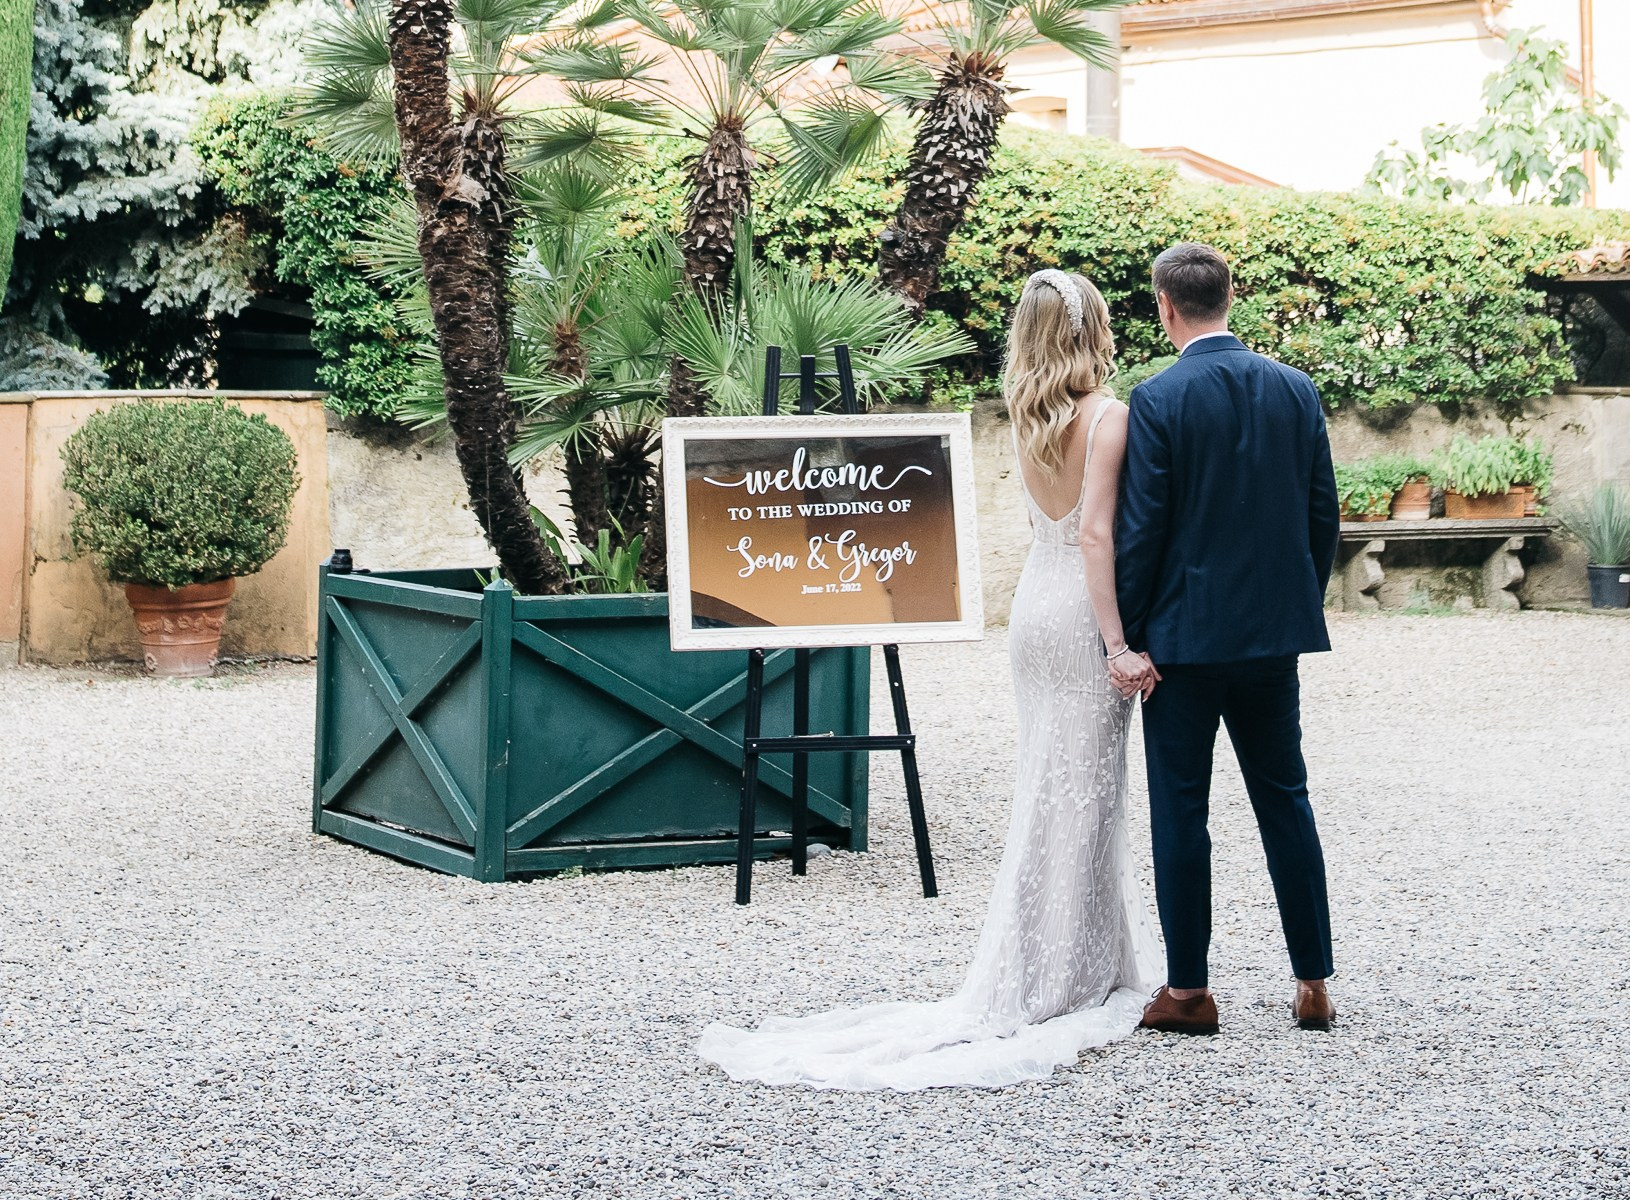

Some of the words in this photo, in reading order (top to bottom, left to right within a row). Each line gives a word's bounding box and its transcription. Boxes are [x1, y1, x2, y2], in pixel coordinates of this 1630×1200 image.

[702, 447, 932, 495] welcome
[727, 507, 753, 521] TO
[756, 505, 793, 519] THE
[797, 501, 884, 517] WEDDING
[887, 499, 912, 513] OF
[726, 536, 799, 578] Sona
[806, 535, 830, 570] &
[824, 529, 917, 583] Gregor
[800, 584, 824, 595] June
[825, 583, 840, 594] 17,
[840, 582, 863, 593] 2022
